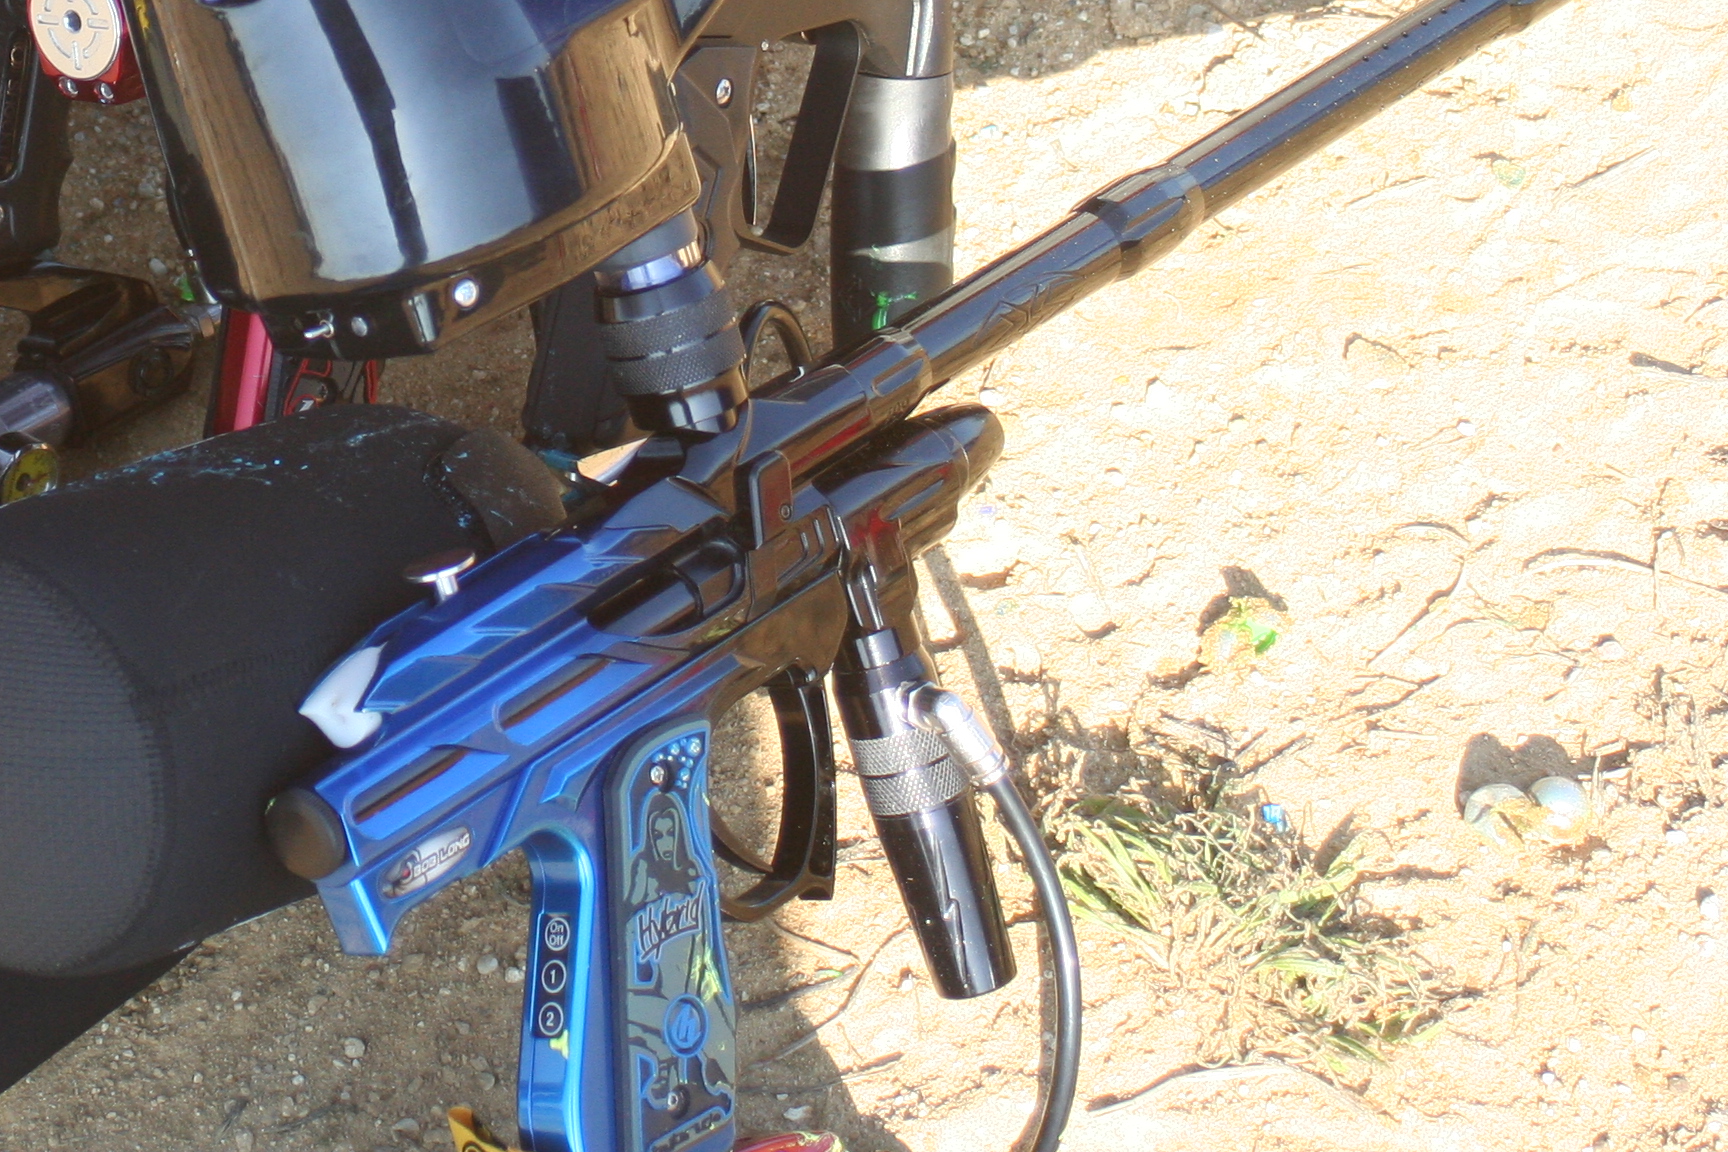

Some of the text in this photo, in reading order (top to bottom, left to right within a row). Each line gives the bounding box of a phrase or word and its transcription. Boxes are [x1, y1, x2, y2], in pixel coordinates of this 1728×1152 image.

[412, 832, 470, 879] BOB LONG
[549, 922, 564, 934] On
[636, 884, 703, 962] Hybrid
[548, 934, 564, 946] Off
[549, 969, 557, 984] 1
[545, 1012, 555, 1027] 2
